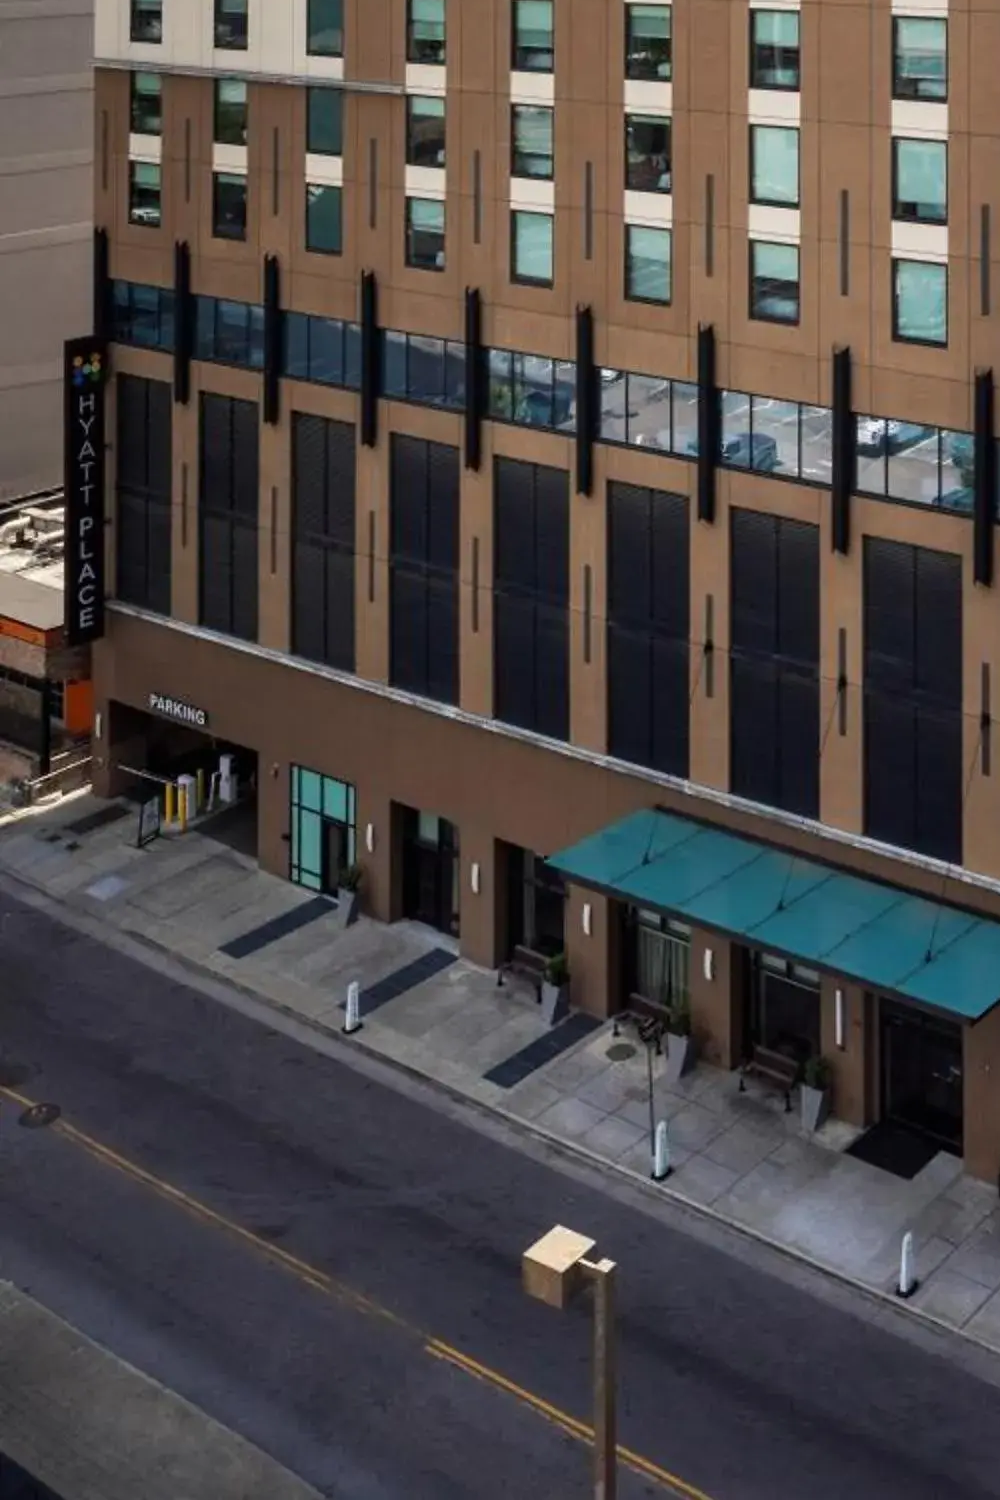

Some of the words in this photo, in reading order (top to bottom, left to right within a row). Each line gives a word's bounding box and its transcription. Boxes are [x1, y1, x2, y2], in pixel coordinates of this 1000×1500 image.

[78, 393, 96, 505] HYATT
[78, 518, 96, 628] PLACE
[149, 693, 205, 725] PARKING
